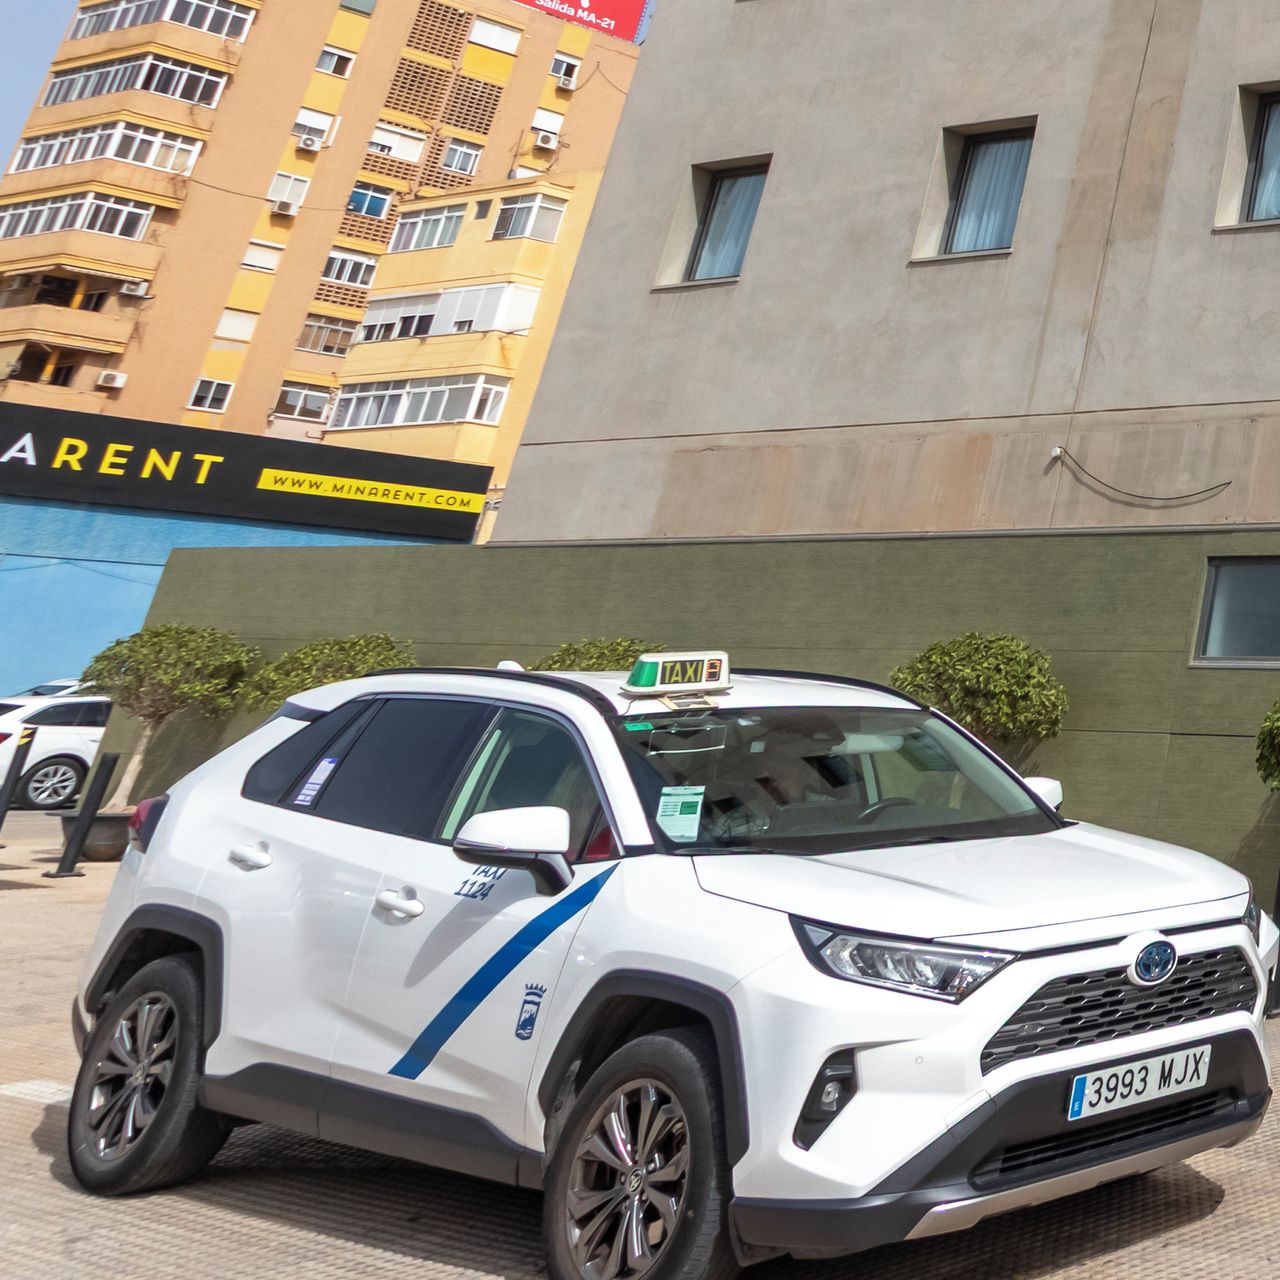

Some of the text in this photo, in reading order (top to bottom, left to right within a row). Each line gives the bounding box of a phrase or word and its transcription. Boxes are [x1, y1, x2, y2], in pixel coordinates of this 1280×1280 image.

[576, 8, 615, 30] MA-21
[272, 475, 472, 508] WWW.MINARENT.COM
[663, 661, 703, 683] TAXI
[454, 879, 495, 900] 1124
[1088, 1065, 1149, 1108] 3993
[1158, 1051, 1205, 1090] MJX
